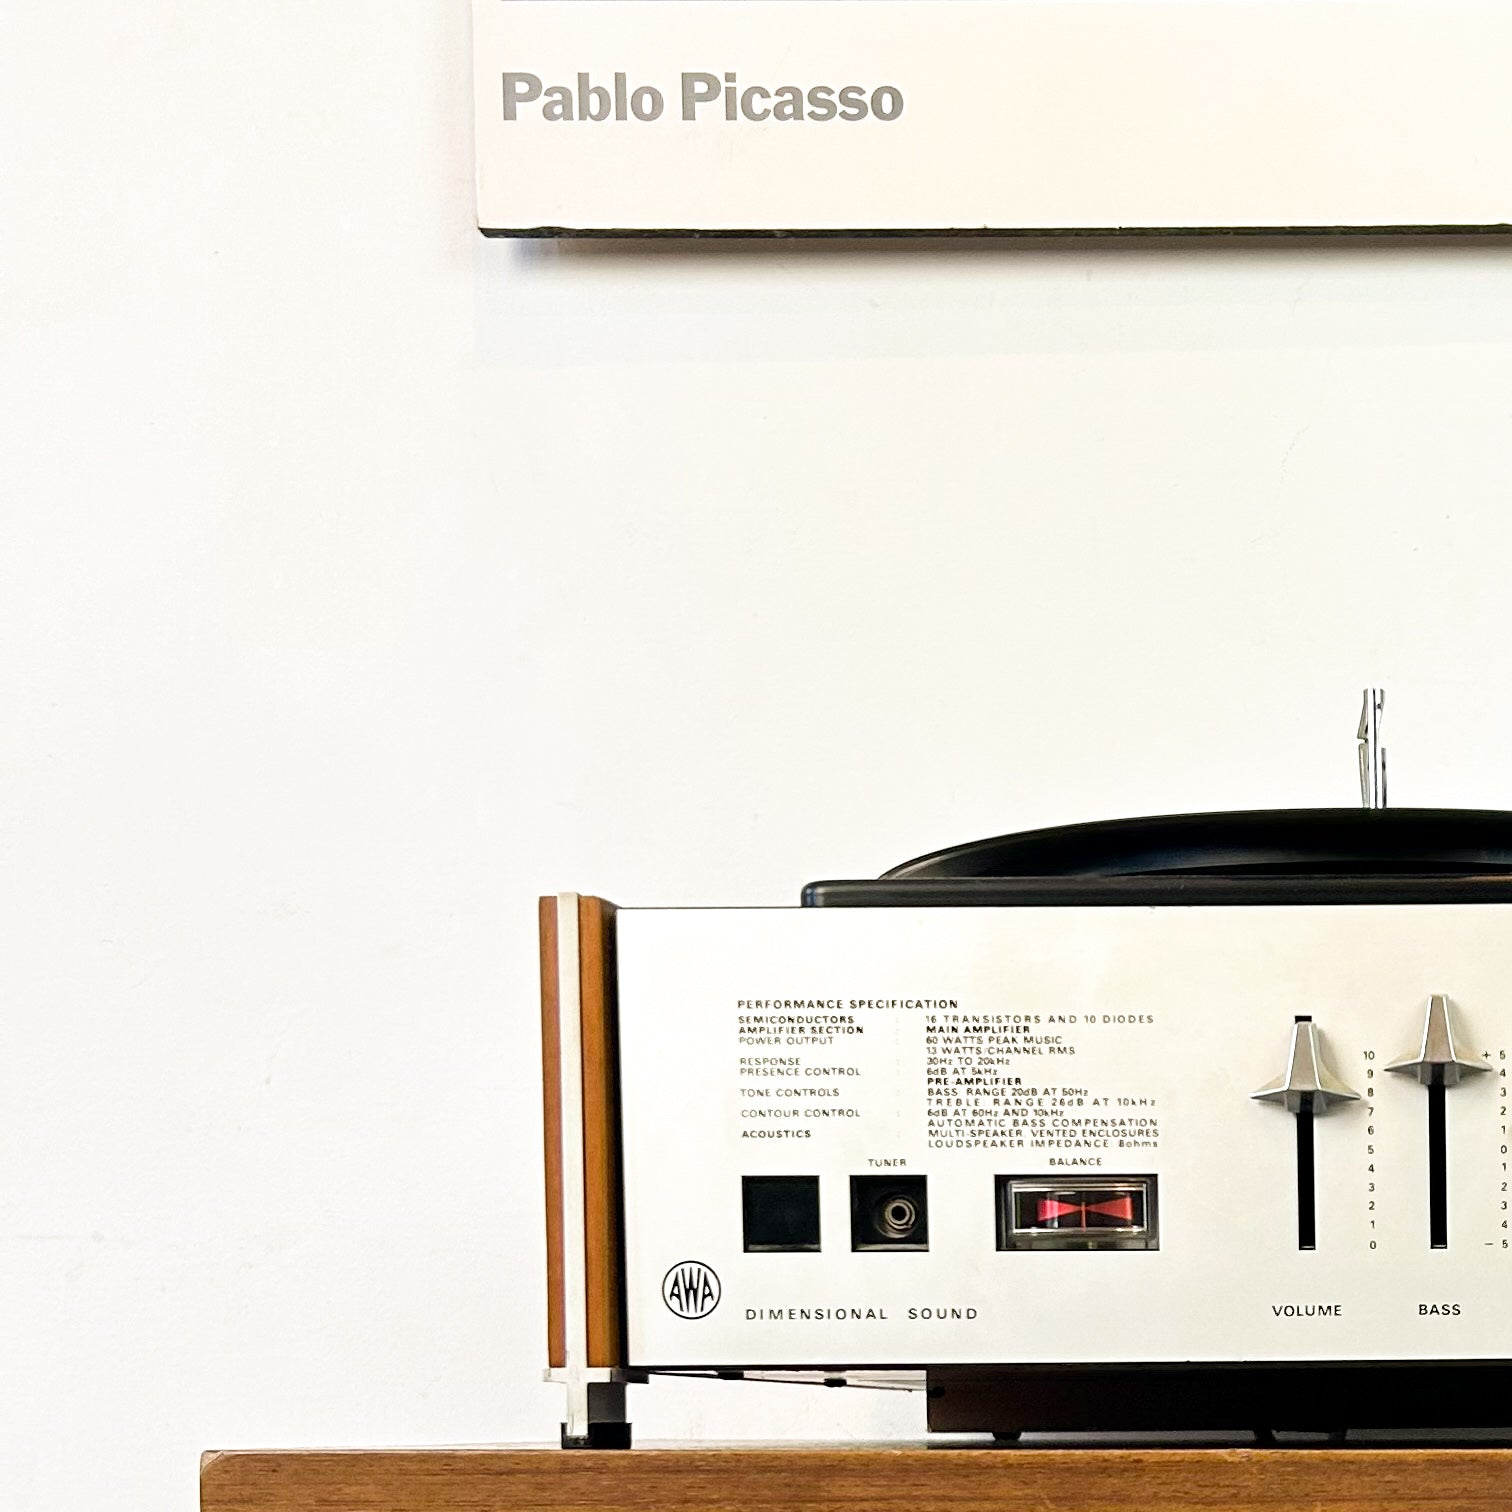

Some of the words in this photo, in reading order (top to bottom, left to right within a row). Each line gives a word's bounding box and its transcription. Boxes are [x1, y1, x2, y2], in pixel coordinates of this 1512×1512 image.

[502, 72, 664, 121] Pablo
[681, 72, 903, 121] Picasso
[737, 999, 843, 1010] PERFORMANCE
[849, 999, 959, 1010] SPECIFICATION
[738, 1015, 855, 1025] SEMICONDUCTORS
[925, 1014, 937, 1024] 16
[943, 1014, 1041, 1024] TRANSISTORS
[1047, 1014, 1077, 1024] AND
[1083, 1014, 1097, 1024] 10
[1101, 1014, 1154, 1024] DIODES
[738, 1025, 806, 1035] AMPLIFIER
[810, 1025, 864, 1035] SECTION
[925, 1025, 959, 1034] MAIN
[963, 1025, 1031, 1034] AMPLIFIER
[738, 1036, 782, 1046] POWER
[786, 1036, 835, 1046] OUTPUT
[942, 1035, 984, 1045] WATTS
[987, 1035, 1019, 1045] PEAK
[1023, 1035, 1063, 1045] MUSIC
[1048, 1046, 1076, 1056] RMS
[739, 1057, 801, 1066] RESPONSE
[957, 1056, 973, 1066] TO
[739, 1067, 800, 1077] PRESENCE
[804, 1067, 862, 1077] CONTROL
[952, 1067, 967, 1076] AT
[739, 1088, 771, 1098] TONE
[775, 1087, 840, 1098] CONTROLS
[966, 1087, 1007, 1097] RANGE
[1042, 1087, 1058, 1097] AT
[993, 1098, 1044, 1107] RANGE
[1092, 1097, 1110, 1107] AT
[1116, 1097, 1156, 1107] 10kHz
[740, 1109, 800, 1118] CONTOUR
[803, 1108, 861, 1118] CONTROL
[952, 1108, 967, 1117] AT
[1002, 1108, 1029, 1117] AND
[927, 1118, 1007, 1128] AUTOMATIC
[1012, 1118, 1047, 1128] BASS
[1051, 1118, 1158, 1128] COMPENSATION
[741, 1129, 812, 1139] ACOUSTICS
[1030, 1129, 1077, 1138] VENTED
[1081, 1128, 1160, 1138] ENCLOSURES
[927, 1139, 1024, 1149] LOUDSPEAKER
[867, 1158, 907, 1168] TUNER
[1049, 1157, 1102, 1167] BALANCE
[670, 1267, 714, 1315] AWA
[745, 1308, 888, 1321] DIMENSIONAL
[907, 1307, 978, 1320] SOUND
[1271, 1304, 1342, 1317] VOLUME
[1418, 1303, 1461, 1316] BASS
